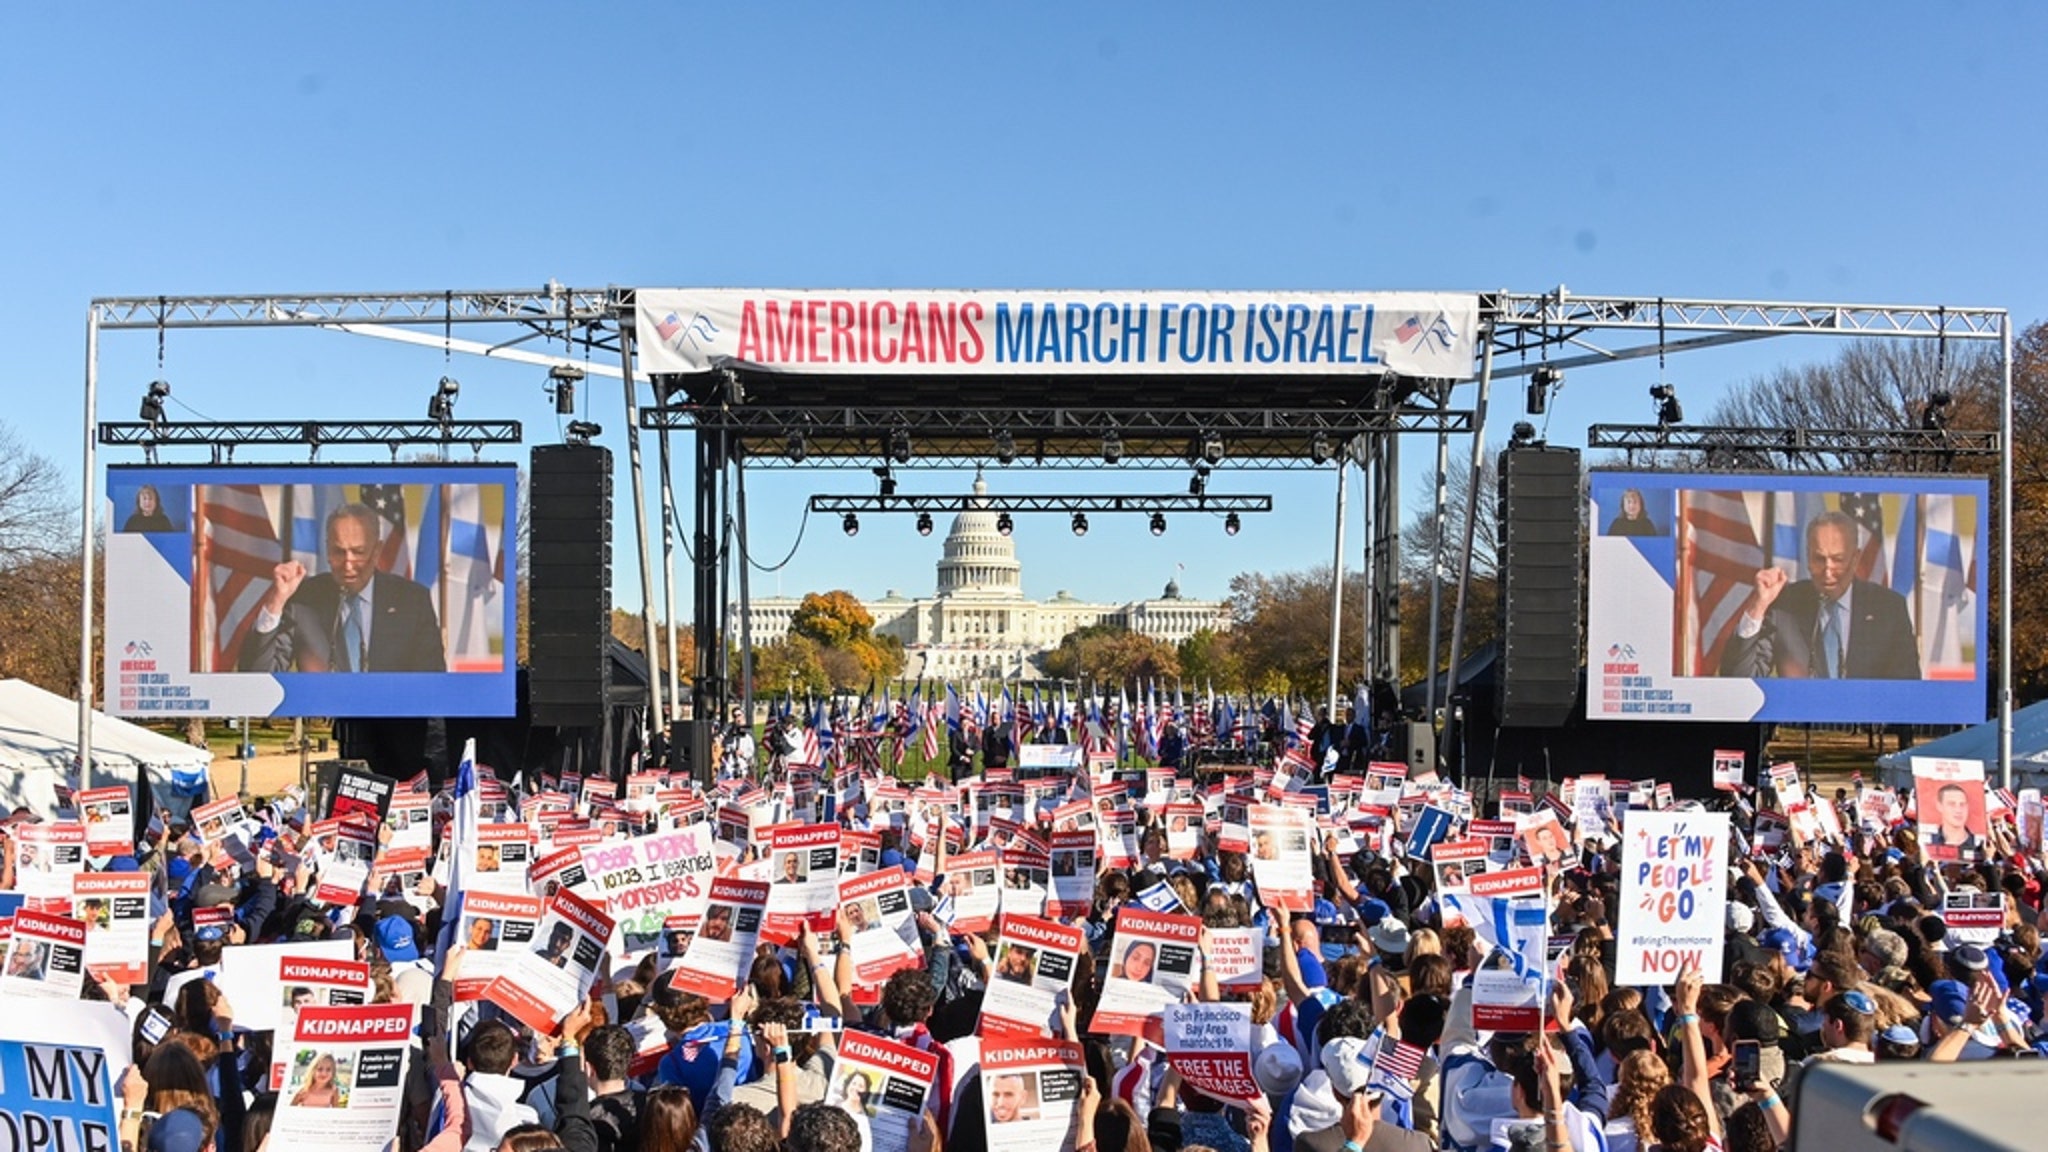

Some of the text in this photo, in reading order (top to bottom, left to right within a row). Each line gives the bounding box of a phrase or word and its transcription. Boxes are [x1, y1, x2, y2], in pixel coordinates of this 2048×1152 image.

[737, 300, 1380, 364] AMERICANS MARCH FOR ISRAEL
[20, 830, 83, 840] KIDNAPPED
[480, 829, 527, 838] IDNAPPED
[1472, 824, 1513, 832] KIDNAPPED
[776, 830, 838, 844] KIDNAPPED
[1052, 836, 1094, 846] KIDNAPPED
[1436, 847, 1485, 858] KIDNAPPED
[1645, 835, 1714, 860] LET MY
[533, 851, 579, 878] KIDNAPPED
[947, 856, 993, 868] KIDNAPPED
[646, 864, 661, 881] I
[1638, 859, 1714, 891] PEOPLE
[76, 879, 147, 890] KIDNAPPED
[842, 874, 900, 897] KIDNAPPED
[1473, 875, 1537, 893] KIDNAPPED
[714, 886, 766, 900] KIDNAPPED
[468, 898, 537, 913] KIDNAPPED
[1657, 889, 1695, 924] GO
[556, 898, 609, 938] KIDNAPPED
[1947, 913, 2001, 922] KIDNAPPED
[17, 917, 83, 938] KIDNAPPED
[1005, 921, 1078, 947] KIDNAPPED
[1121, 917, 1196, 937] KIDNAPPED
[1212, 937, 1250, 945] EREVER
[1632, 935, 1713, 948] #BringThemHome
[1230, 956, 1255, 964] WITH
[1642, 950, 1703, 972] NOW
[284, 965, 366, 981] KIDNAPPED
[1215, 966, 1239, 974] RAEL
[1173, 1009, 1241, 1023] San Francisco
[302, 1017, 408, 1035] KIDNAPPED
[1186, 1023, 1229, 1037] Bay Area
[1179, 1035, 1234, 1049] marches to
[845, 1040, 932, 1076] KIDNAPPED
[985, 1047, 1079, 1064] KIDNAPPED
[24, 1045, 105, 1105] MY
[1174, 1059, 1245, 1078] FREE THE
[1188, 1076, 1256, 1095] OSTAGES
